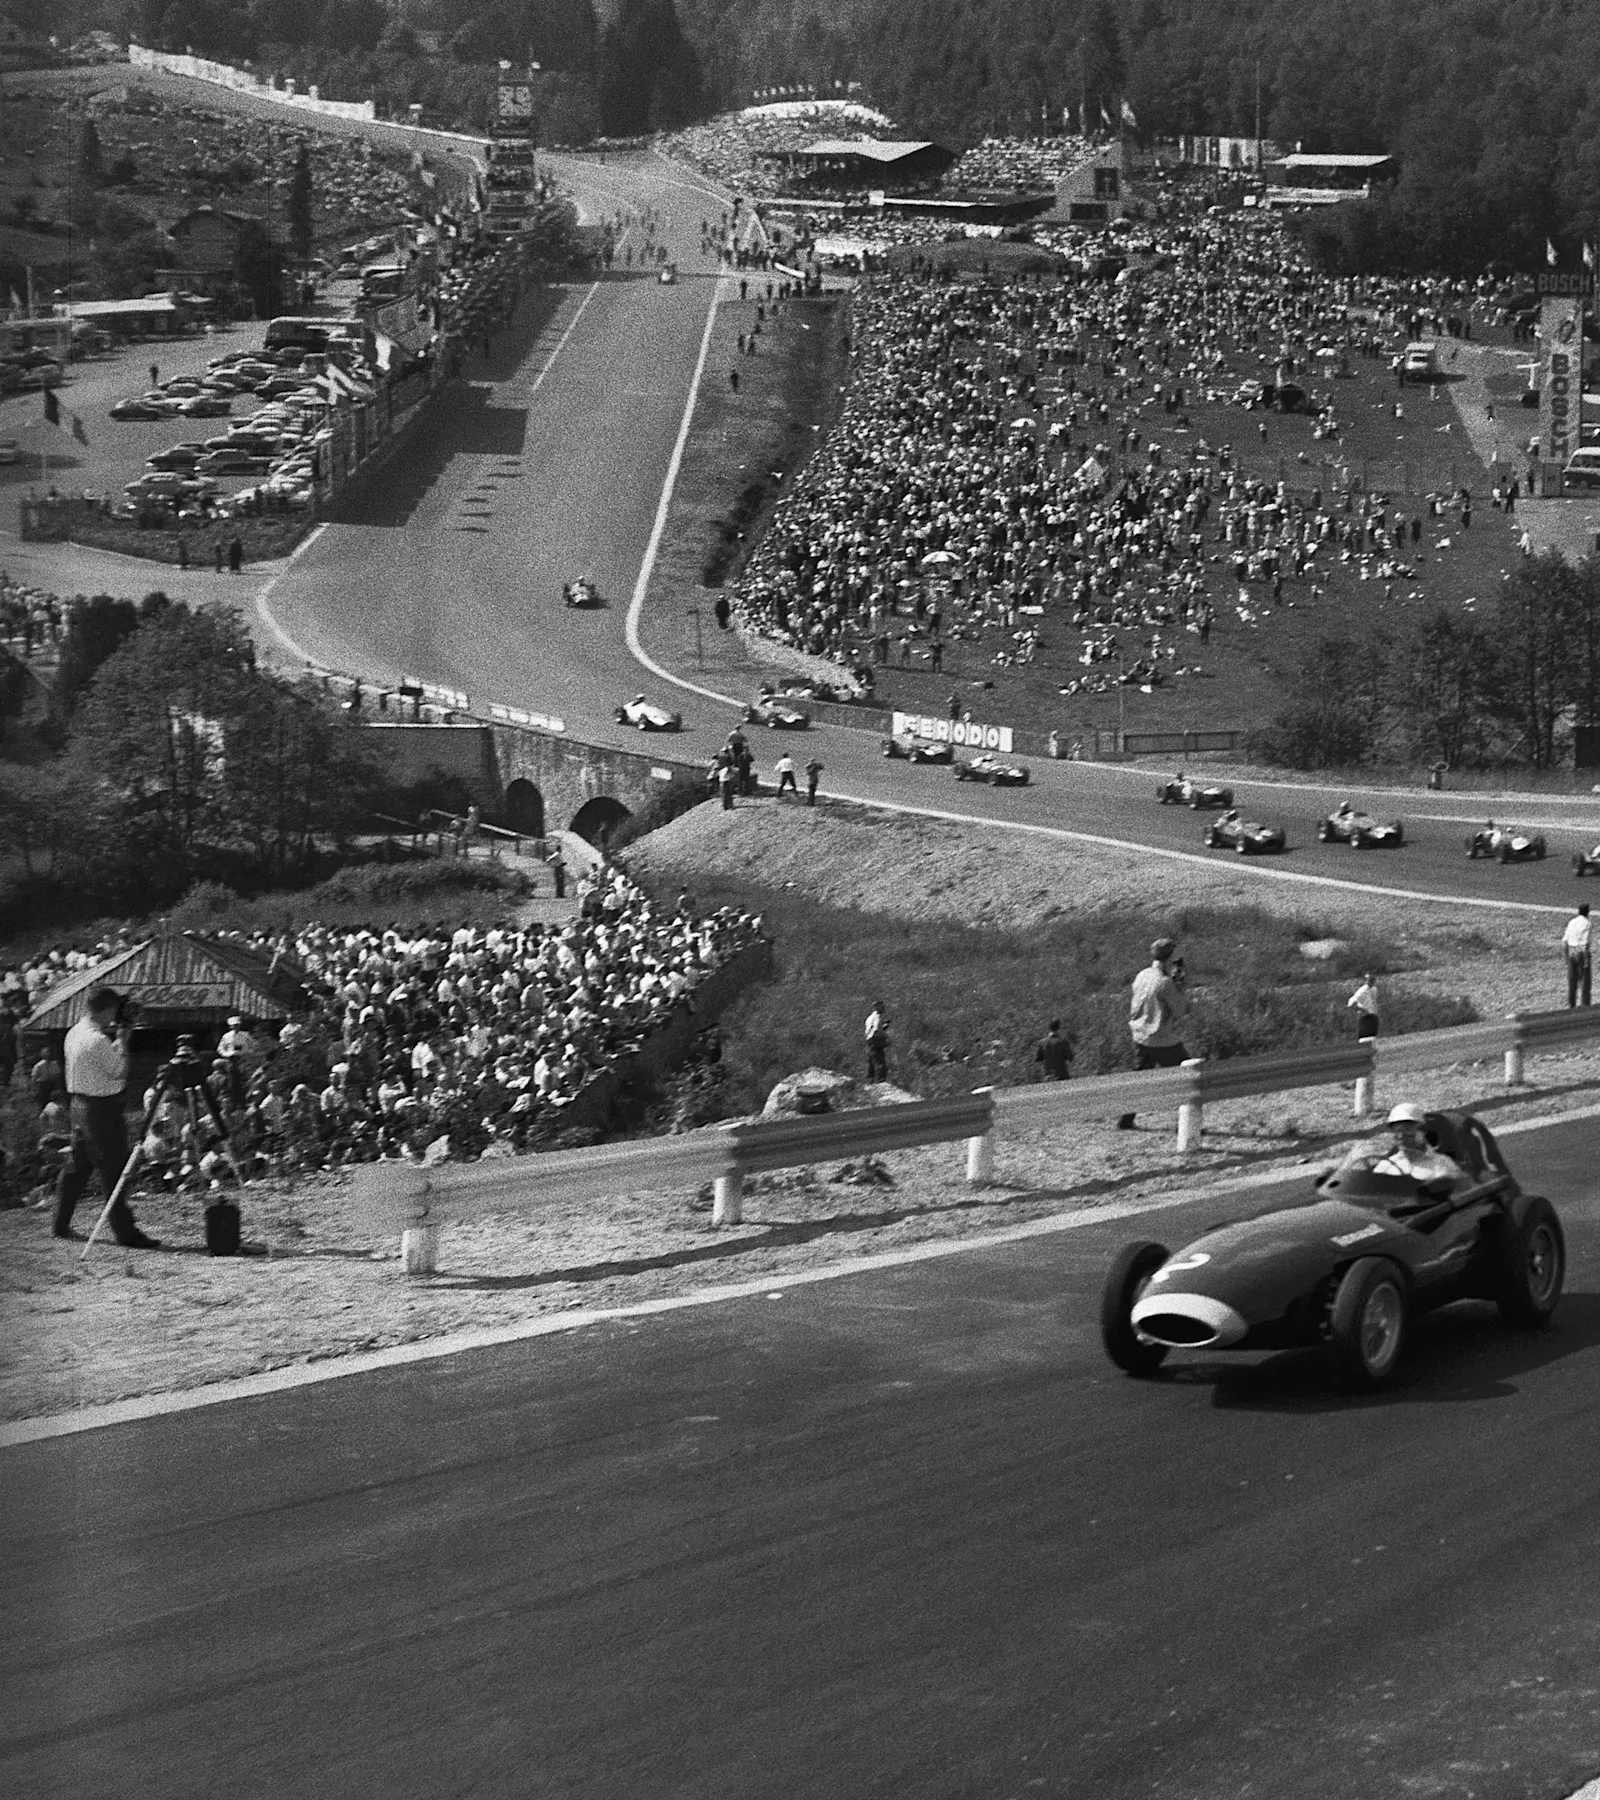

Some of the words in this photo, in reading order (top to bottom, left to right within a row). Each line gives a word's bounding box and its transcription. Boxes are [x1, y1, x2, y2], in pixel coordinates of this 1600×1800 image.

[1538, 273, 1591, 293] BOSCH
[1551, 353, 1570, 458] BOSCH
[903, 714, 999, 748] FERODO
